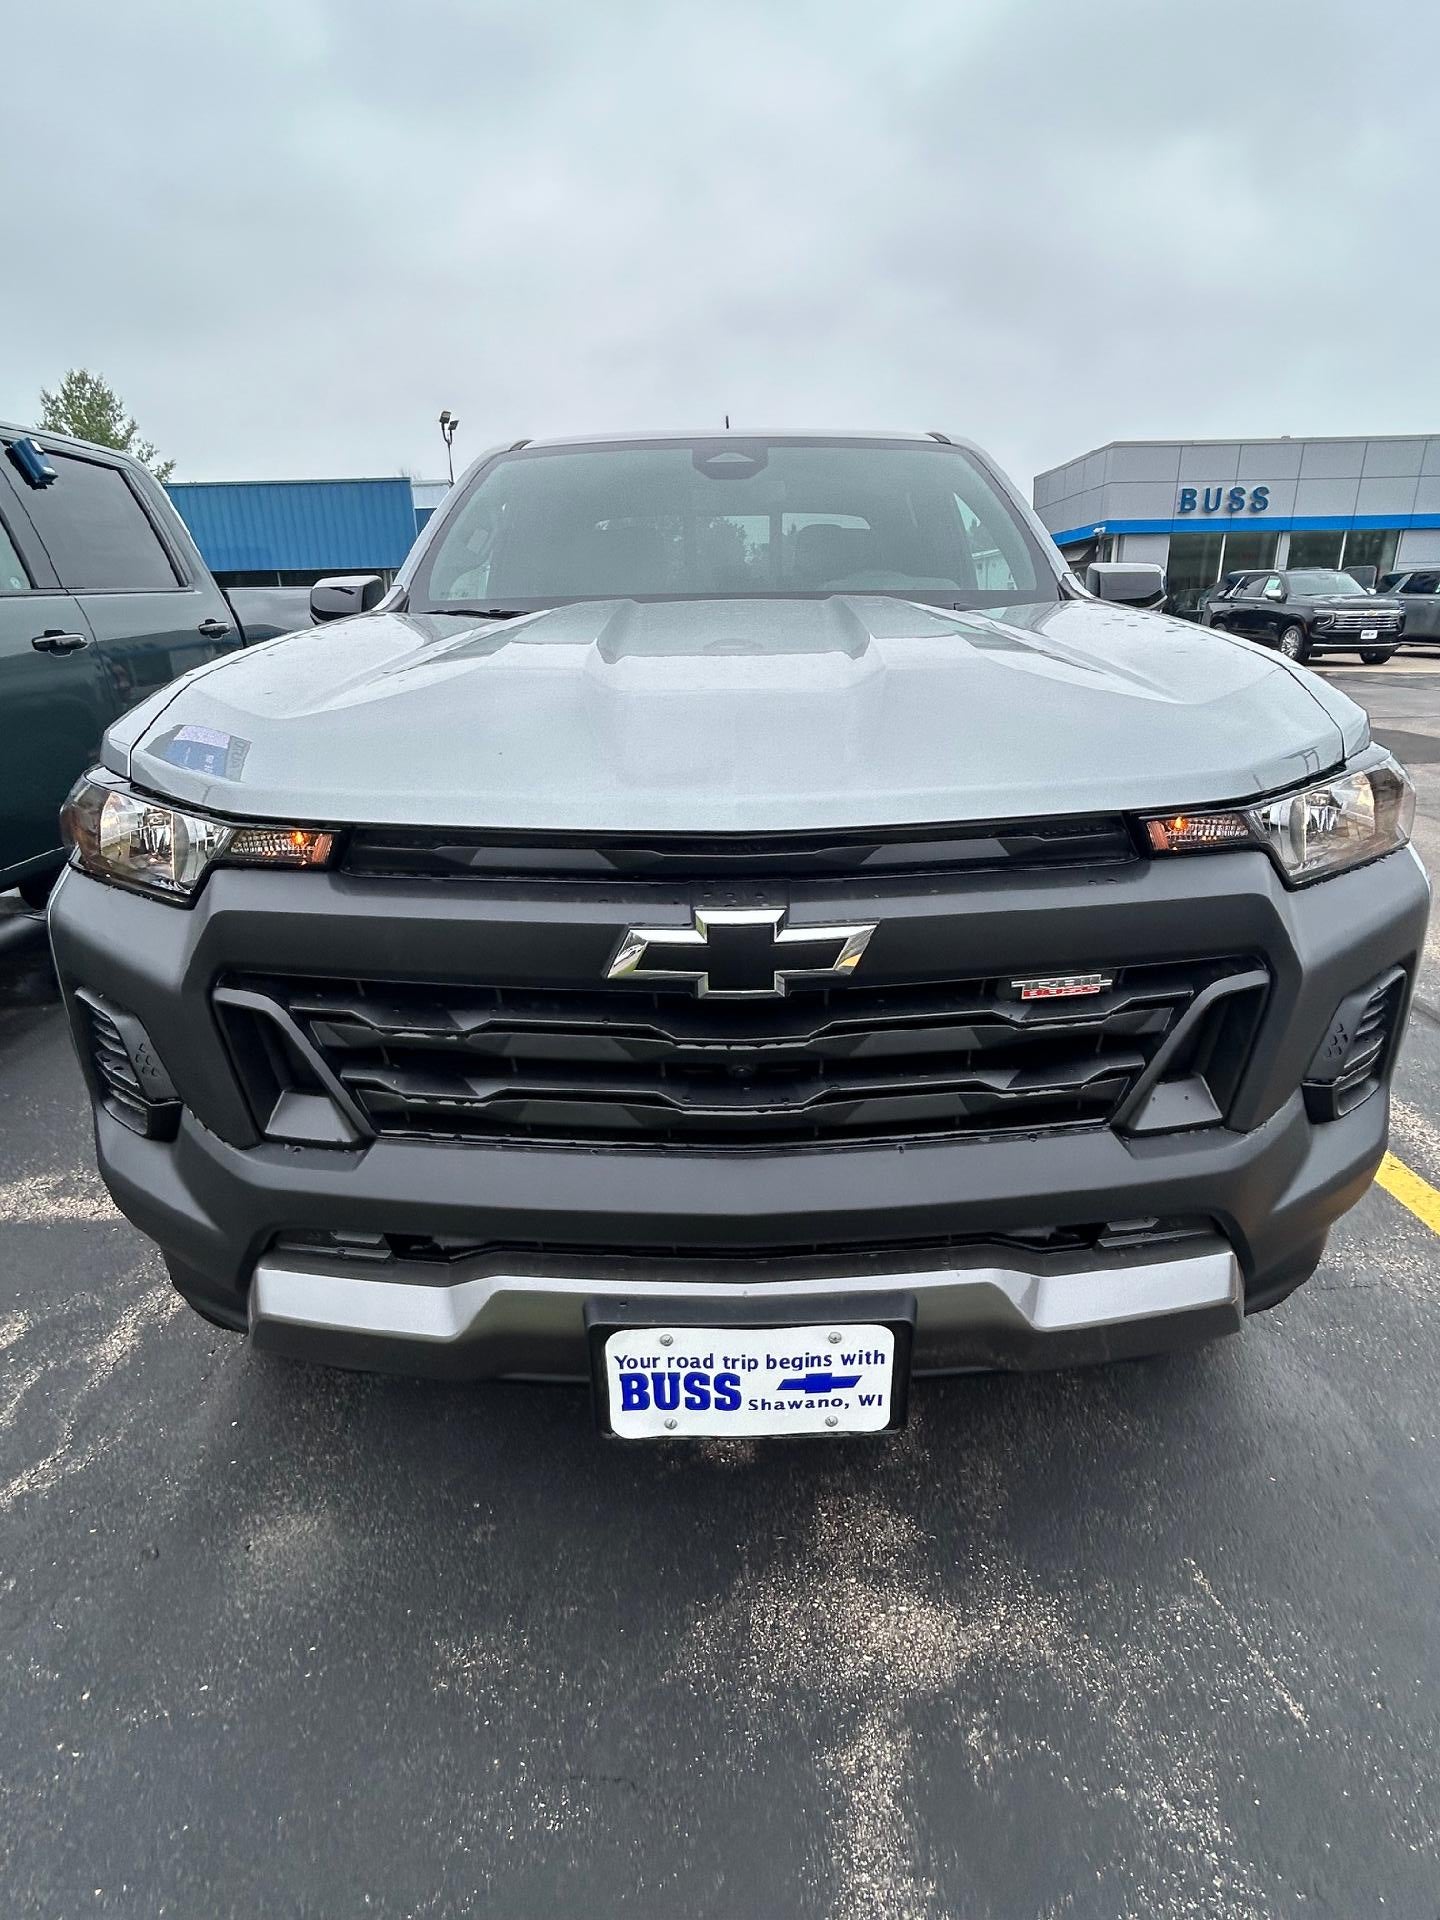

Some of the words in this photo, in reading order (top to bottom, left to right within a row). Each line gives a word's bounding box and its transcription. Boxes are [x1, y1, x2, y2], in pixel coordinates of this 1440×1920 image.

[1178, 486, 1270, 513] BUSS
[614, 1354, 661, 1370] Your
[667, 1352, 714, 1370] road
[722, 1354, 760, 1373] trip
[766, 1352, 833, 1371] begins
[840, 1349, 886, 1366] with
[619, 1371, 742, 1412] BUSS
[748, 1398, 851, 1411] Shawano,
[858, 1394, 883, 1407] WI
